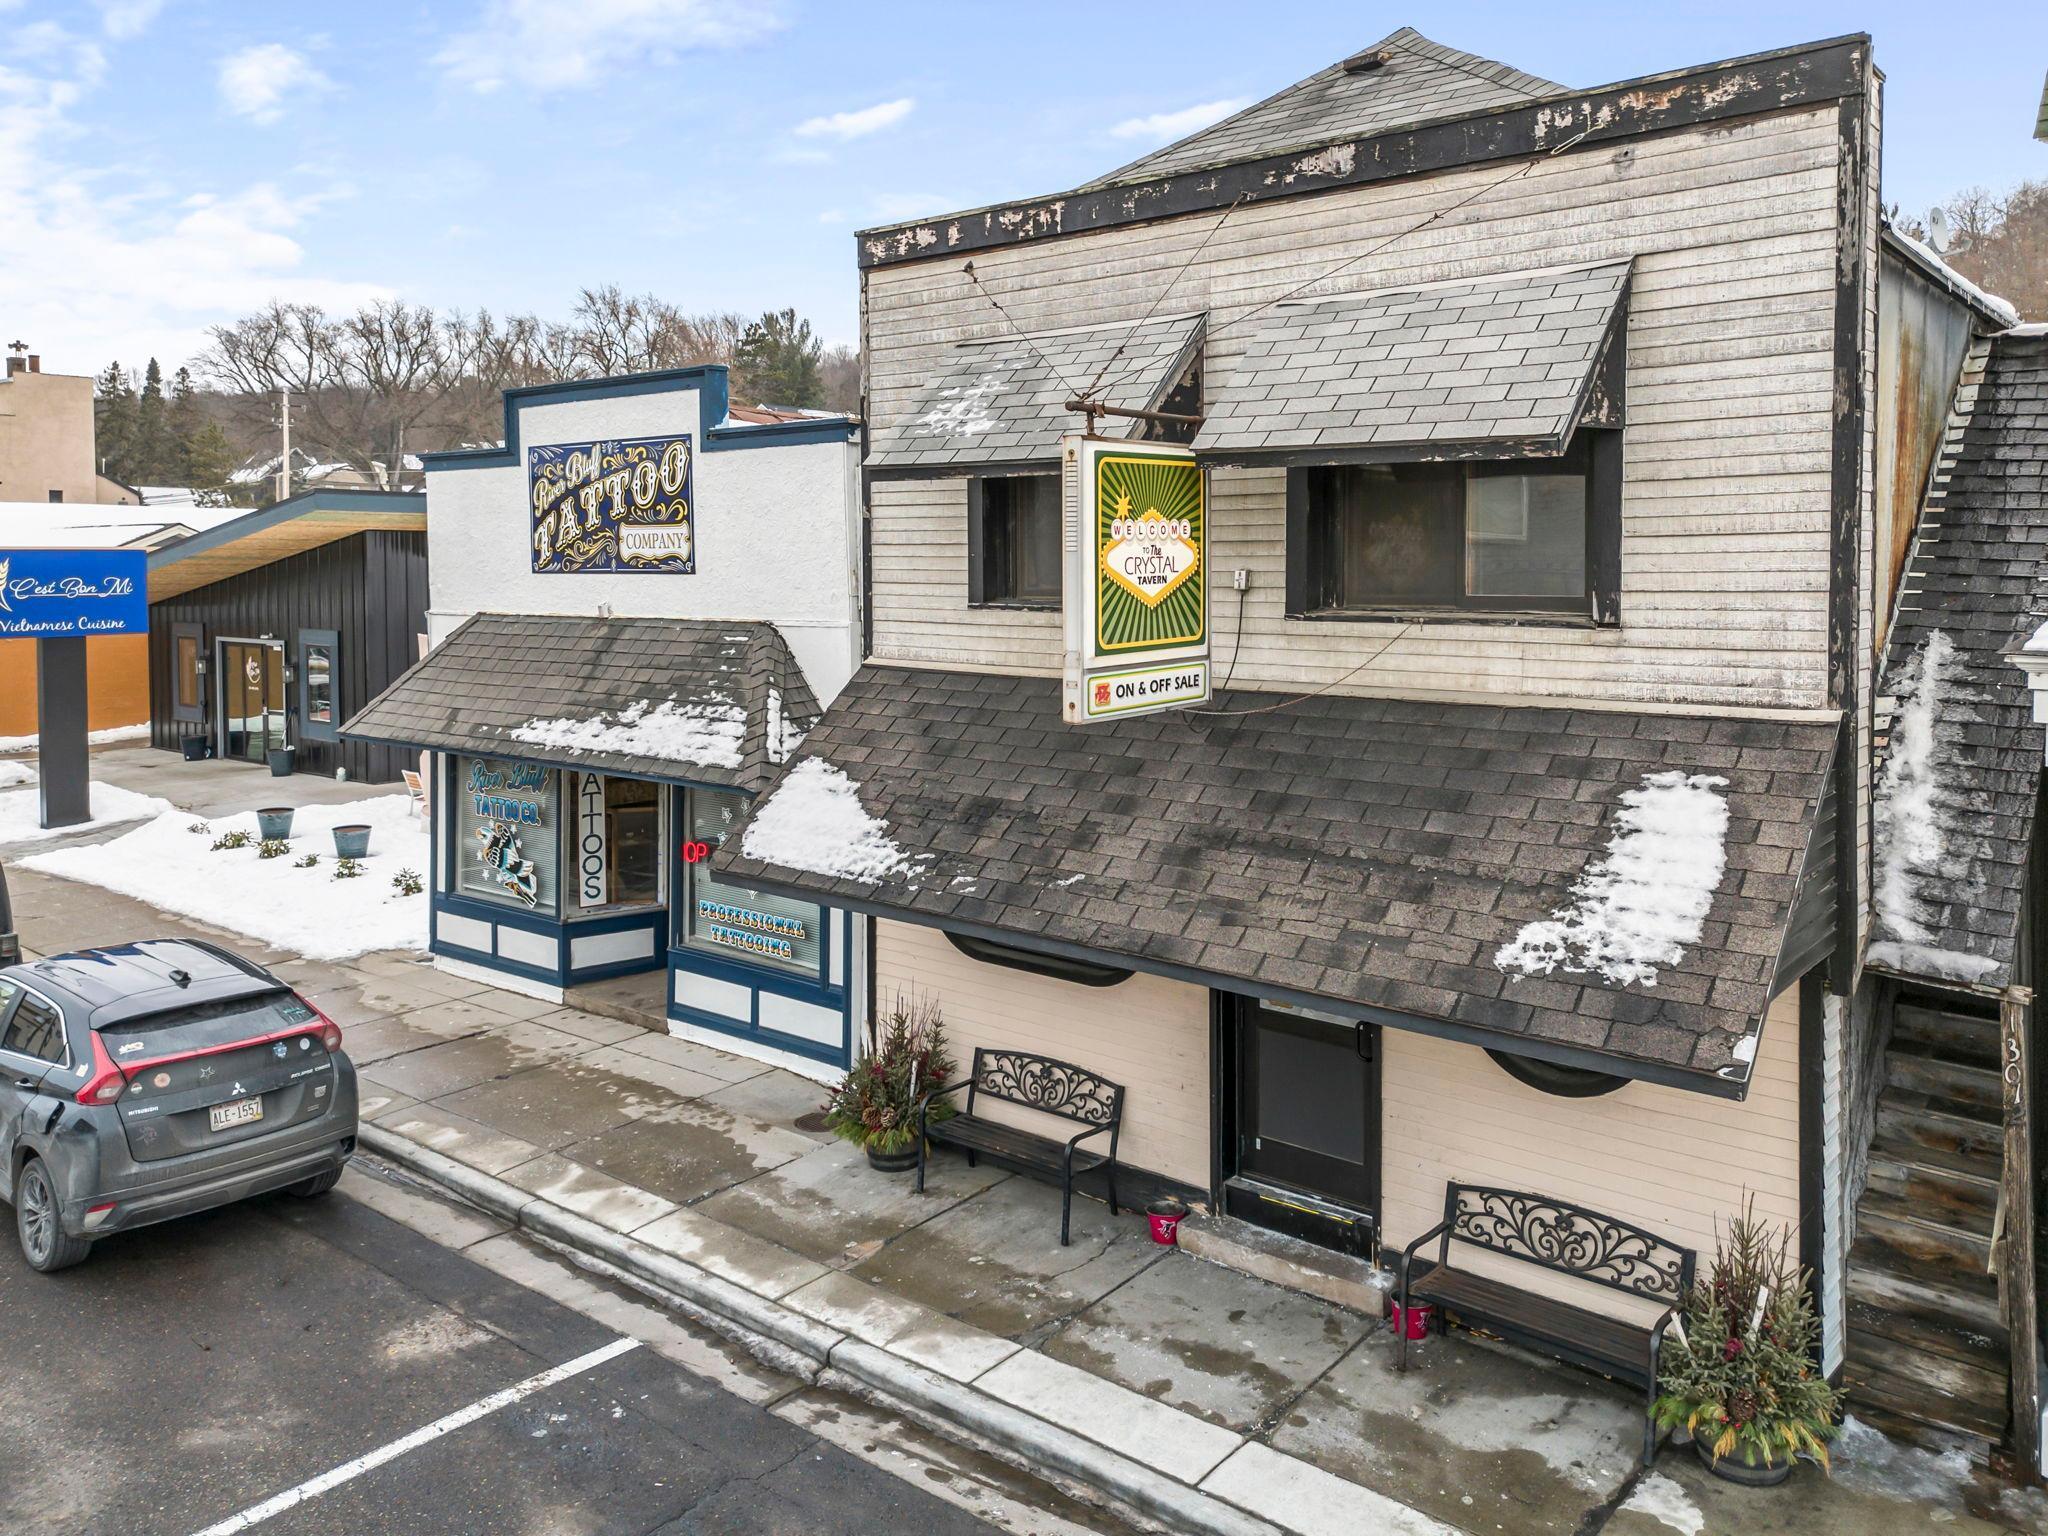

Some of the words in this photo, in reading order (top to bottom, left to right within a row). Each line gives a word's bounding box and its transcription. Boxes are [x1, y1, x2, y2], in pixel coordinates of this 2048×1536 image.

[533, 477, 566, 518] River
[565, 442, 602, 490] Bluff
[534, 441, 690, 568] TATTOO
[626, 532, 684, 550] COMPANY
[1113, 525, 1188, 536] WELCOME
[1150, 544, 1162, 556] The
[1124, 555, 1179, 575] CRYSTAL
[9, 577, 56, 600] C'est
[59, 577, 98, 599] Bon
[1137, 575, 1168, 585] TAVERN
[0, 618, 75, 632] Vietnamese
[78, 616, 126, 630] Cuisine
[1115, 683, 1134, 699] ON
[1138, 681, 1146, 695] &
[1149, 677, 1171, 693] OFF
[1174, 674, 1200, 690] SALE
[466, 759, 505, 794] River
[474, 794, 521, 823] TATTOO
[581, 772, 603, 900] ATTOOS
[698, 900, 806, 939] PROFESSIONAL
[710, 924, 792, 959] TATTOOING
